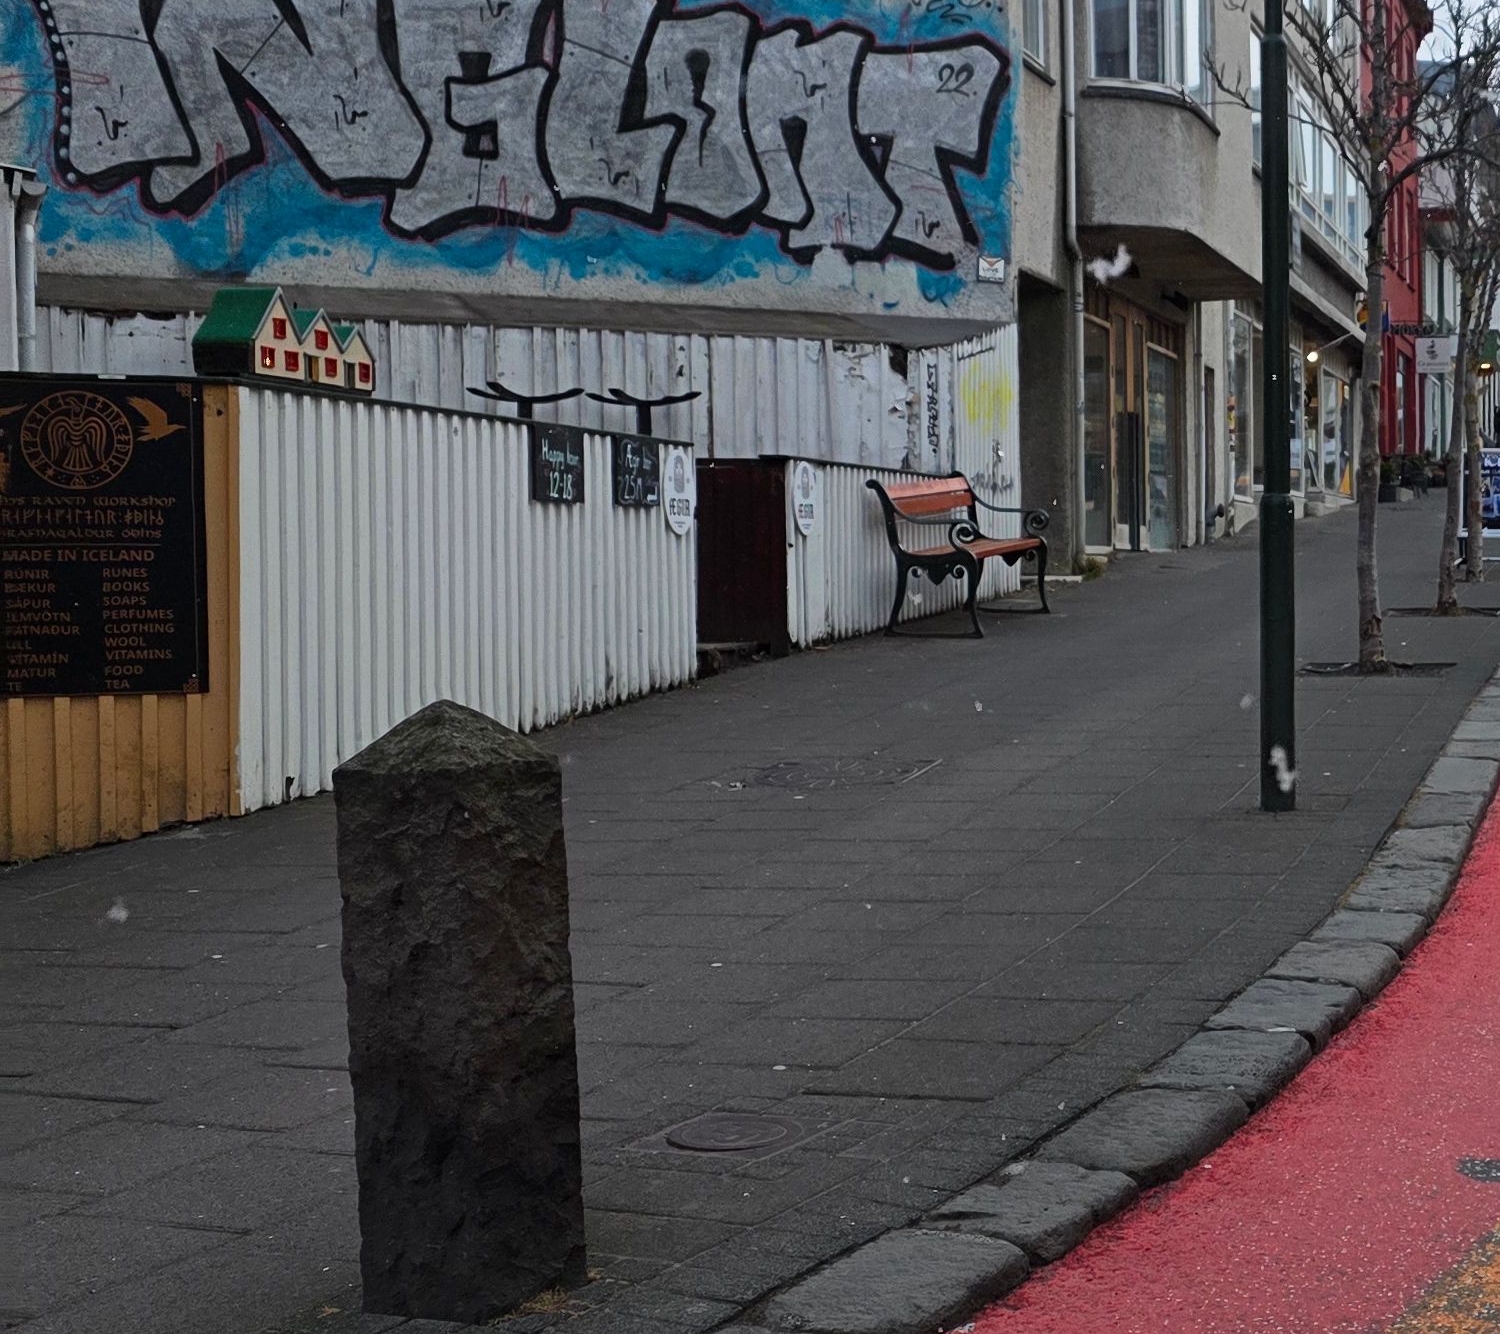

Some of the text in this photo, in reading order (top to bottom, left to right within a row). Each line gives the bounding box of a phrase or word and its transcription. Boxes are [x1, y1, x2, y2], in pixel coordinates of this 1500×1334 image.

[2, 548, 155, 562] MADE IN ICELAND
[102, 567, 148, 579] RUNES
[102, 581, 151, 593] BOOKS
[103, 595, 147, 606] SOAPS
[102, 609, 175, 620] PERFUMES
[104, 622, 175, 634] CLOTHING
[104, 636, 146, 648] WOOL
[105, 649, 173, 660] VITAMINS
[7, 667, 57, 679] MATUR
[104, 665, 145, 676] FOOD
[8, 681, 22, 692] TE
[105, 679, 131, 690] TEA
